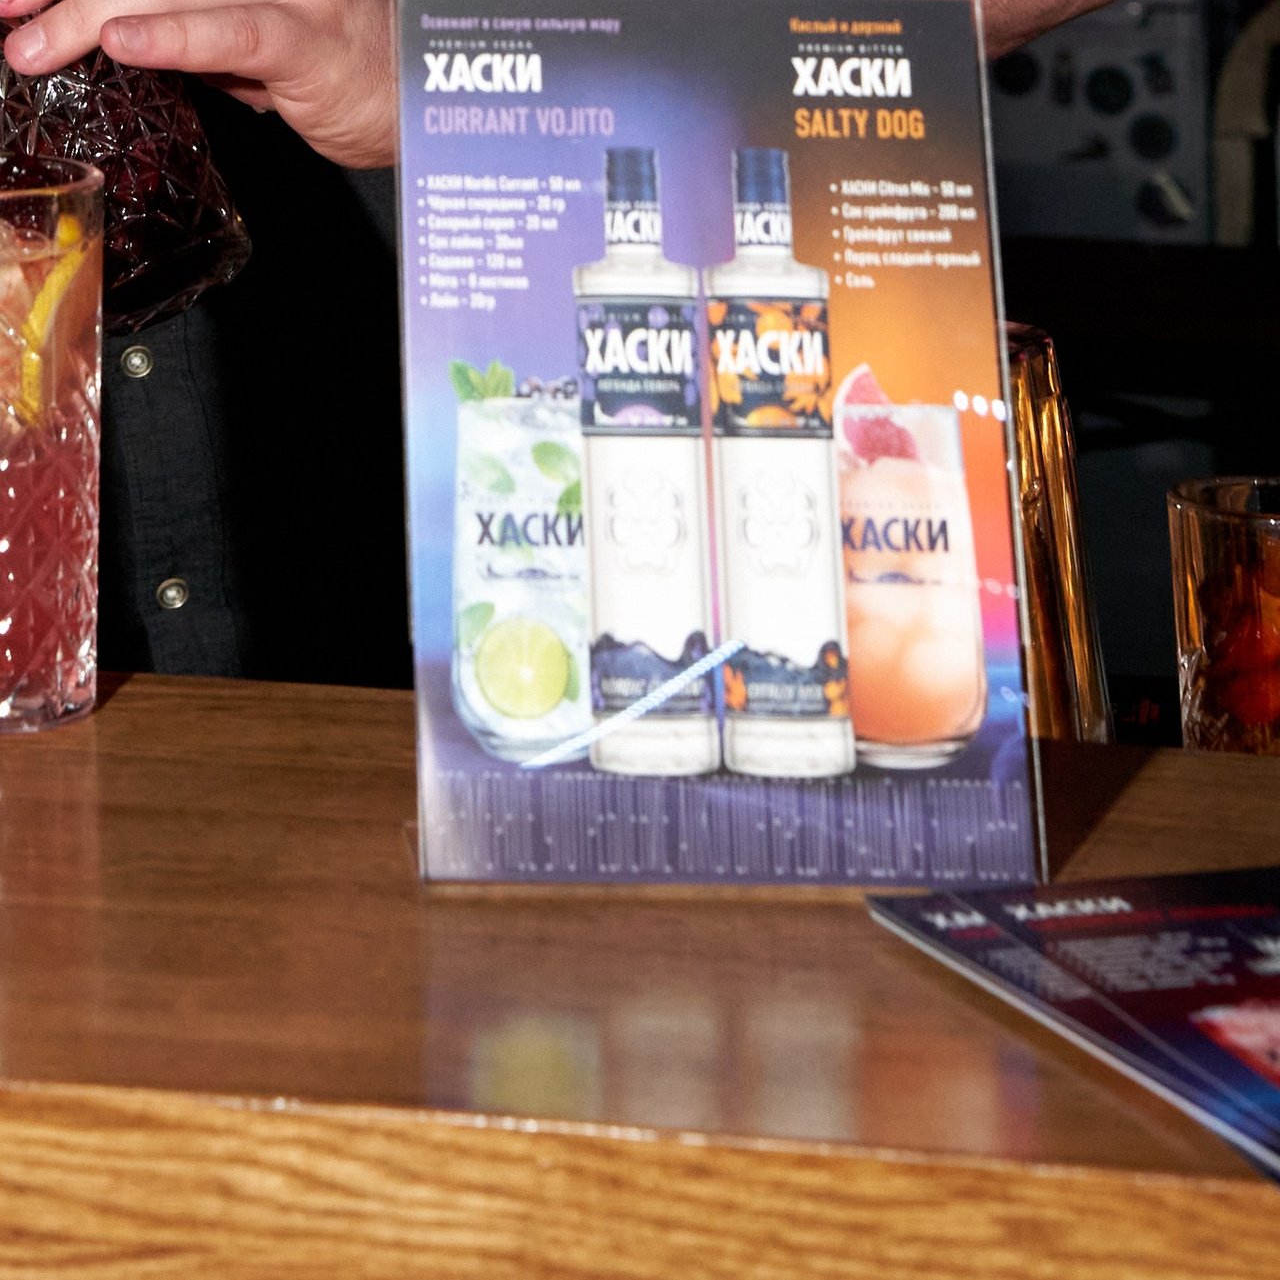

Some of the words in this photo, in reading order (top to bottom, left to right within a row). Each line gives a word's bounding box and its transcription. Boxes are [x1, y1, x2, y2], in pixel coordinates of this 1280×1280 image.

[423, 52, 543, 94] ХАСКИ
[791, 56, 913, 99] ХАСКИ
[424, 105, 530, 135] CURRANT
[535, 106, 615, 137] VOJITO
[794, 107, 869, 138] SALTY
[876, 108, 926, 140] DOG
[585, 327, 693, 376] ХАСКИ
[716, 329, 825, 377] ХАСКИ
[477, 512, 585, 547] ХАСКИ
[840, 517, 949, 552] ХАСКИ
